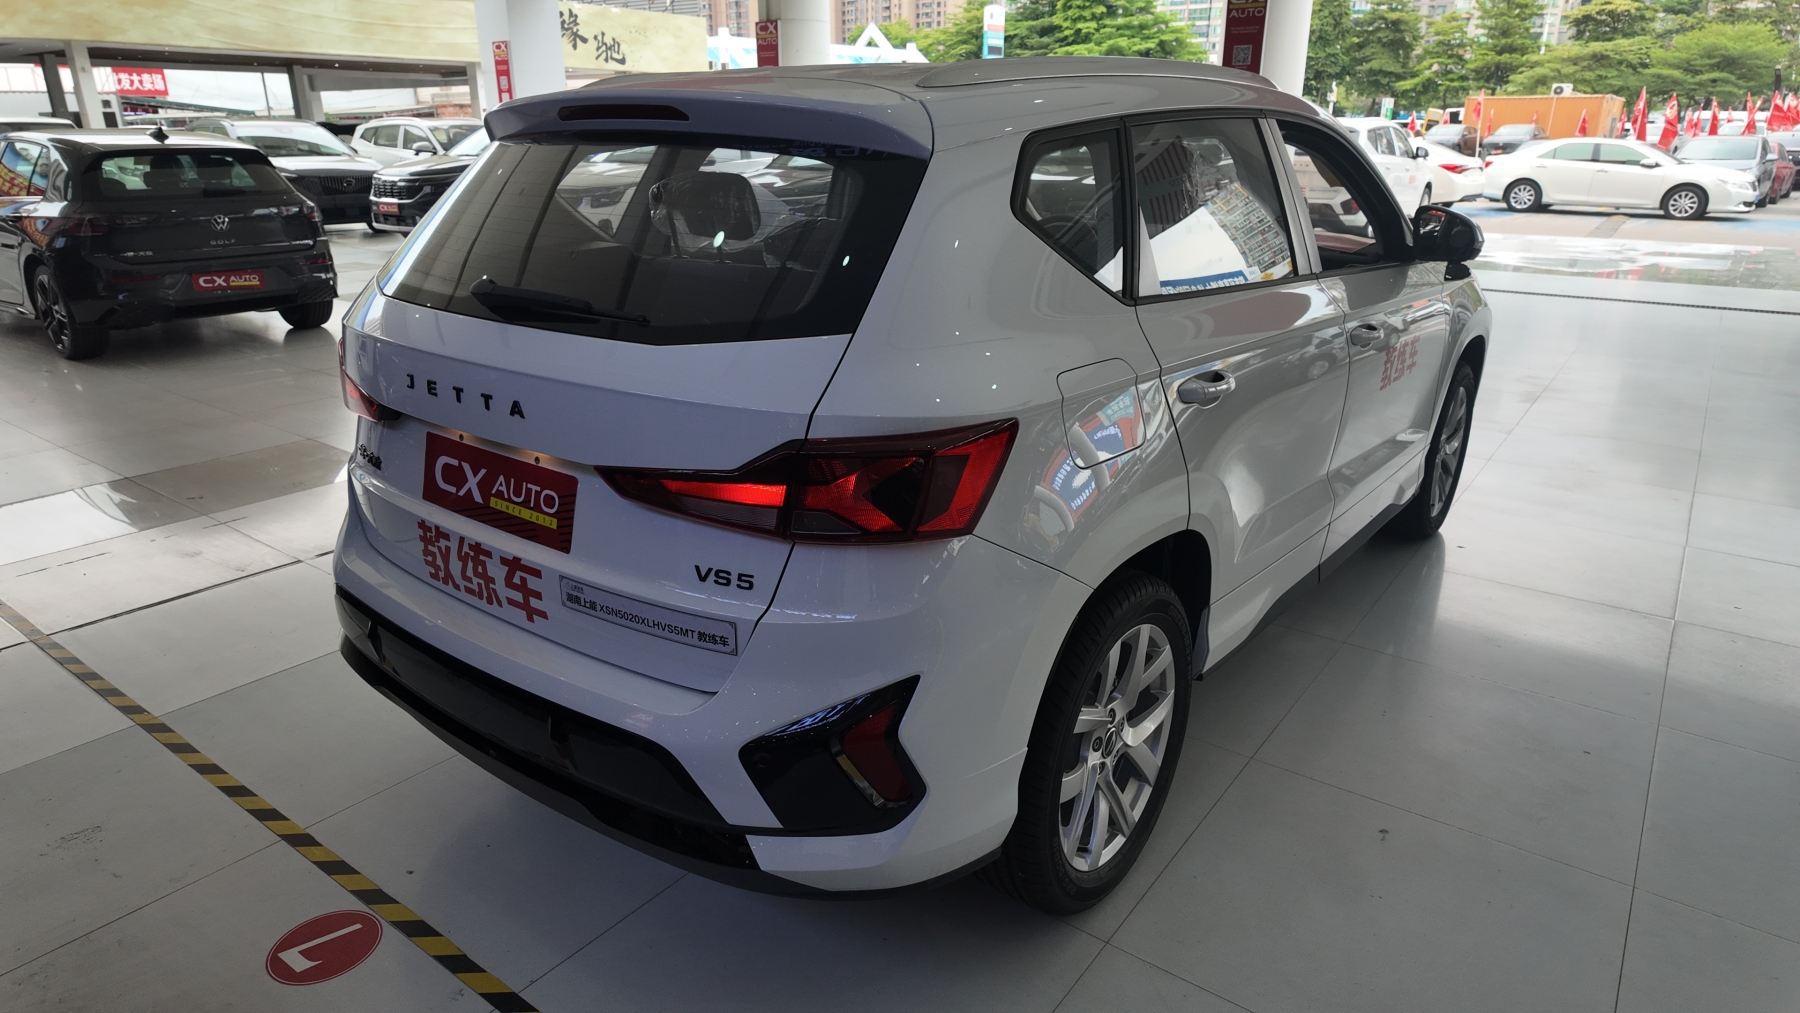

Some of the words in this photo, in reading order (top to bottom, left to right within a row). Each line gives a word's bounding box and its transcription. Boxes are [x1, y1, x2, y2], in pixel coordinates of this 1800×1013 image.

[1229, 8, 1265, 18] AUTO
[757, 22, 777, 34] CX
[493, 42, 507, 52] CX
[198, 276, 227, 287] CX
[229, 274, 259, 283] AUTO
[1380, 335, 1420, 391] 教练车
[406, 373, 526, 419] JETTA
[434, 455, 487, 504] CX
[491, 475, 559, 514] AUTO
[494, 500, 522, 515] SINCE
[529, 513, 553, 526] 2012
[417, 519, 549, 624] 教练车
[694, 564, 755, 591] VS5
[566, 591, 598, 612] 湖南上能
[598, 603, 696, 640] XSN5020XLHVS5MT
[697, 630, 730, 648] 教练车
